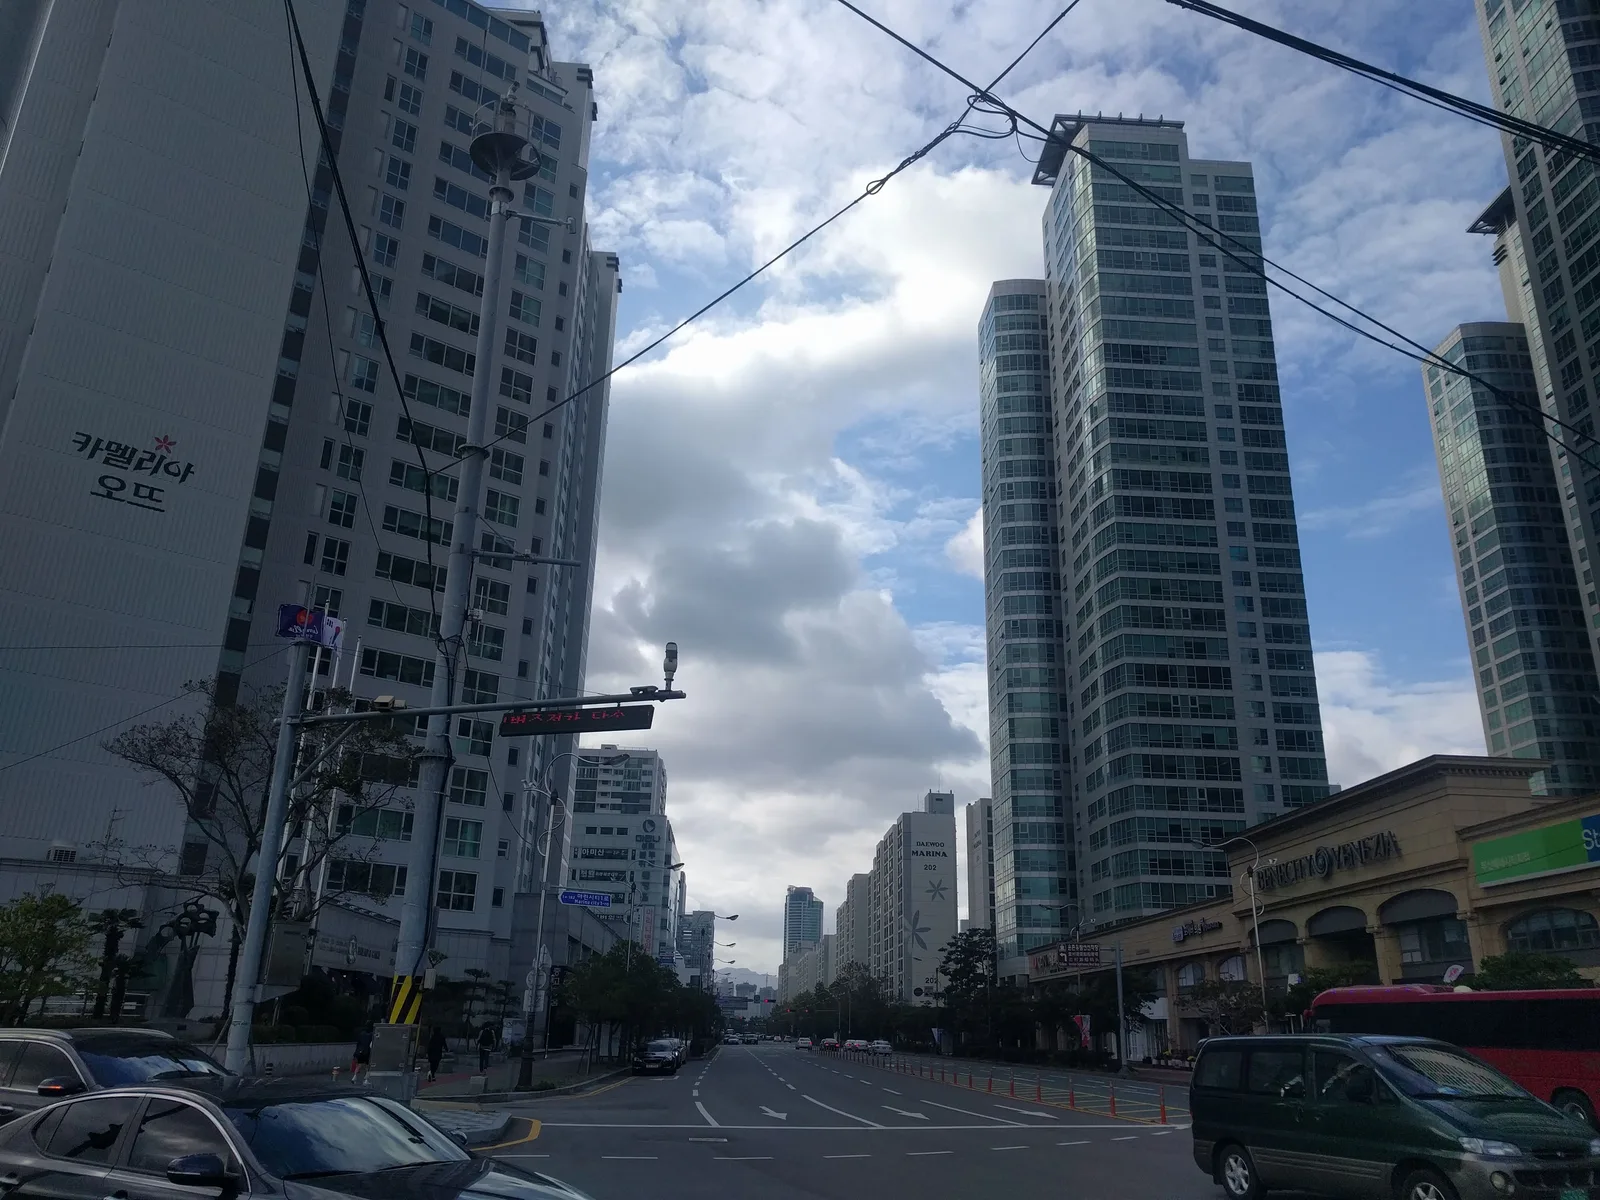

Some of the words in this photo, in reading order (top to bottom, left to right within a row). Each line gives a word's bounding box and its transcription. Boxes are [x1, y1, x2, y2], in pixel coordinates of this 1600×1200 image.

[72, 431, 195, 484] 카멜리아
[90, 474, 165, 512] 오뜨
[582, 848, 605, 856] 아미산
[911, 850, 948, 858] MARINA
